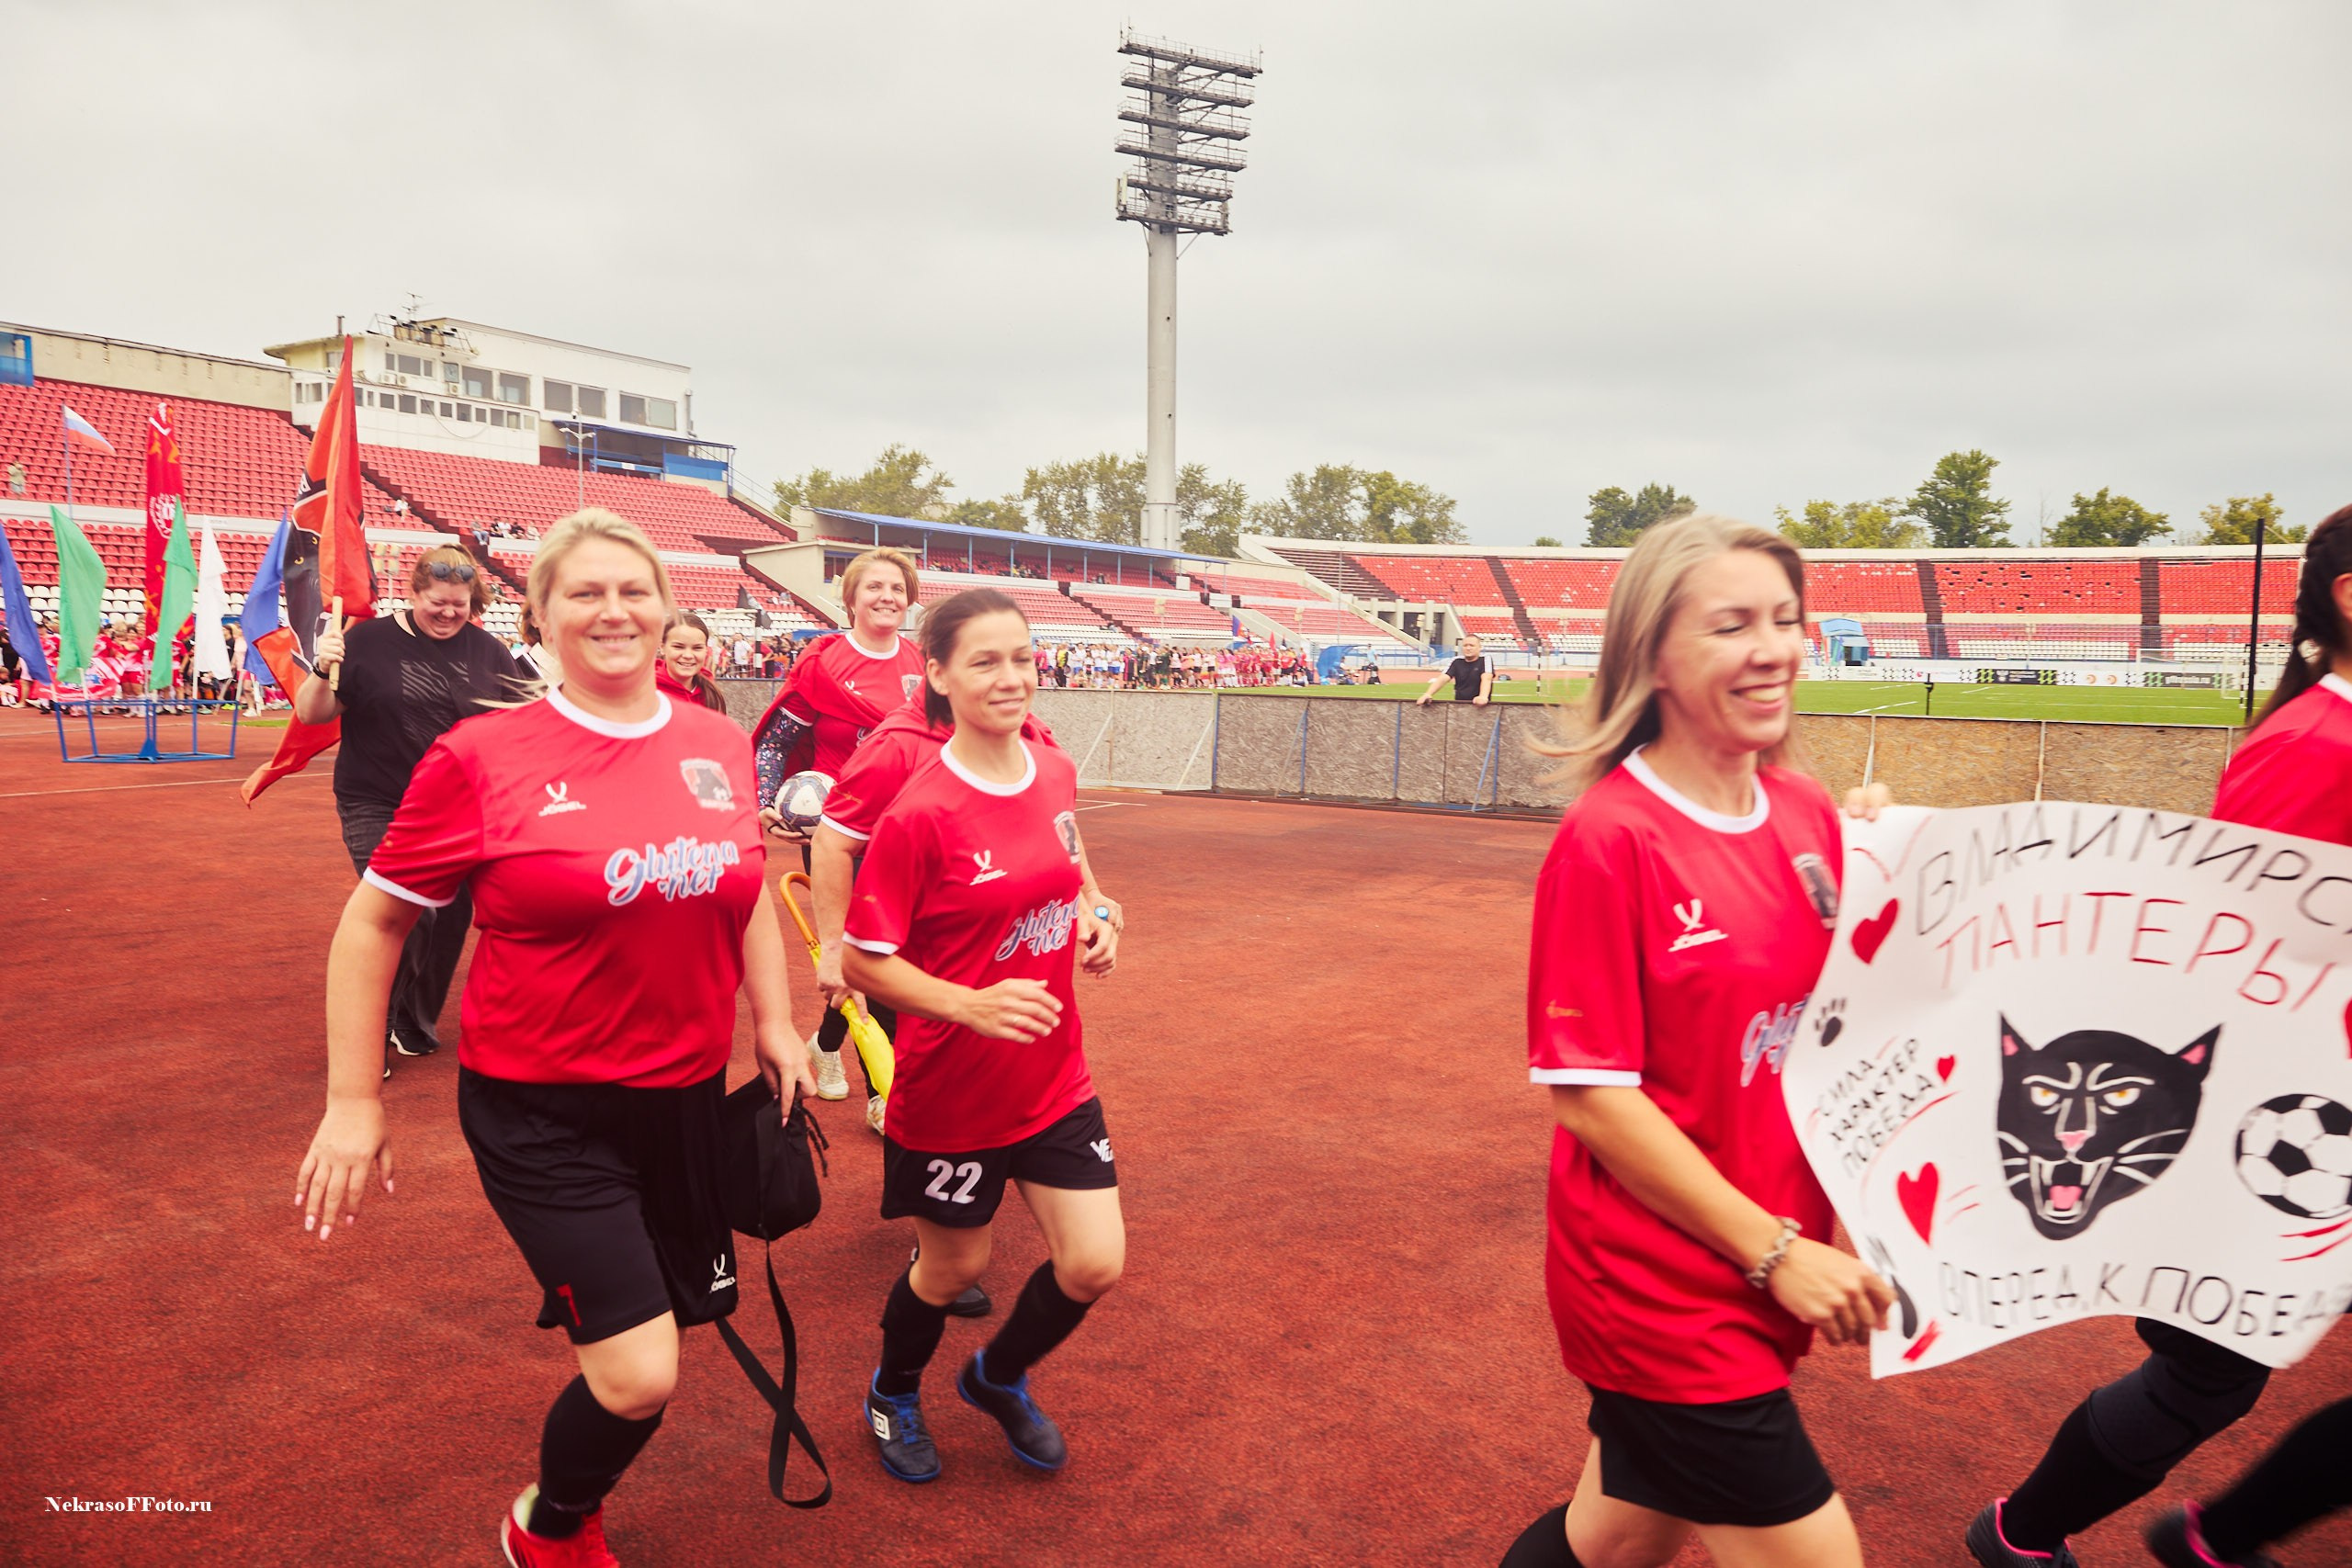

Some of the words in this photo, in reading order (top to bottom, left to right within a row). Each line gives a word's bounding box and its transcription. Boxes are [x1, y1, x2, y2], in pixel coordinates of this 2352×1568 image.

[1917, 806, 2352, 935] ВЛАДИМИРС
[1934, 890, 2338, 1014] ПАНТЕРЫ
[1829, 1037, 1919, 1150] ХАРАКТЕР
[1841, 1073, 1934, 1179] ПОБЕДА
[924, 1158, 983, 1203] 22
[2093, 1262, 2128, 1307] К
